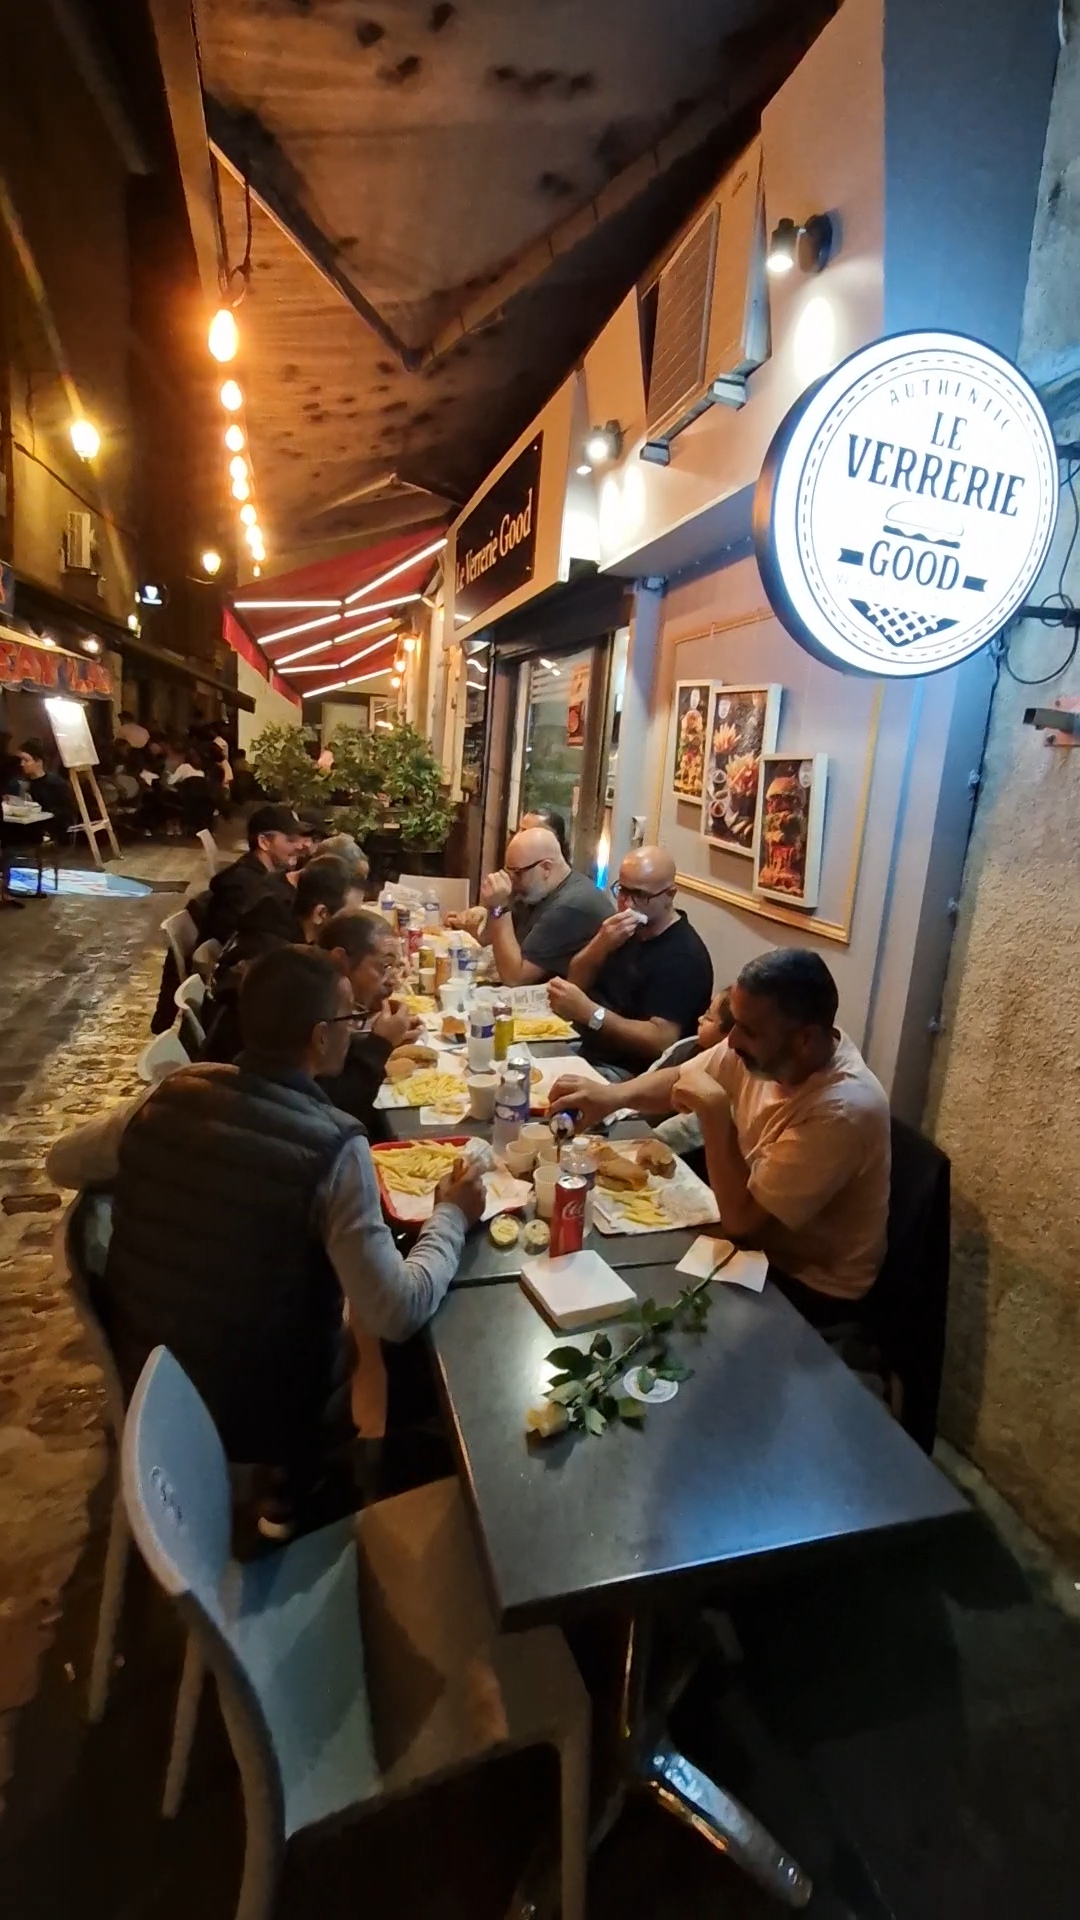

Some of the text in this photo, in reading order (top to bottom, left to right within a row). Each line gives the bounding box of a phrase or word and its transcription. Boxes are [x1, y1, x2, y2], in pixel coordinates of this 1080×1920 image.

[930, 411, 968, 452] LE
[848, 433, 1026, 517] VERRERIE
[500, 487, 532, 557] Good
[870, 540, 961, 591] GOOD
